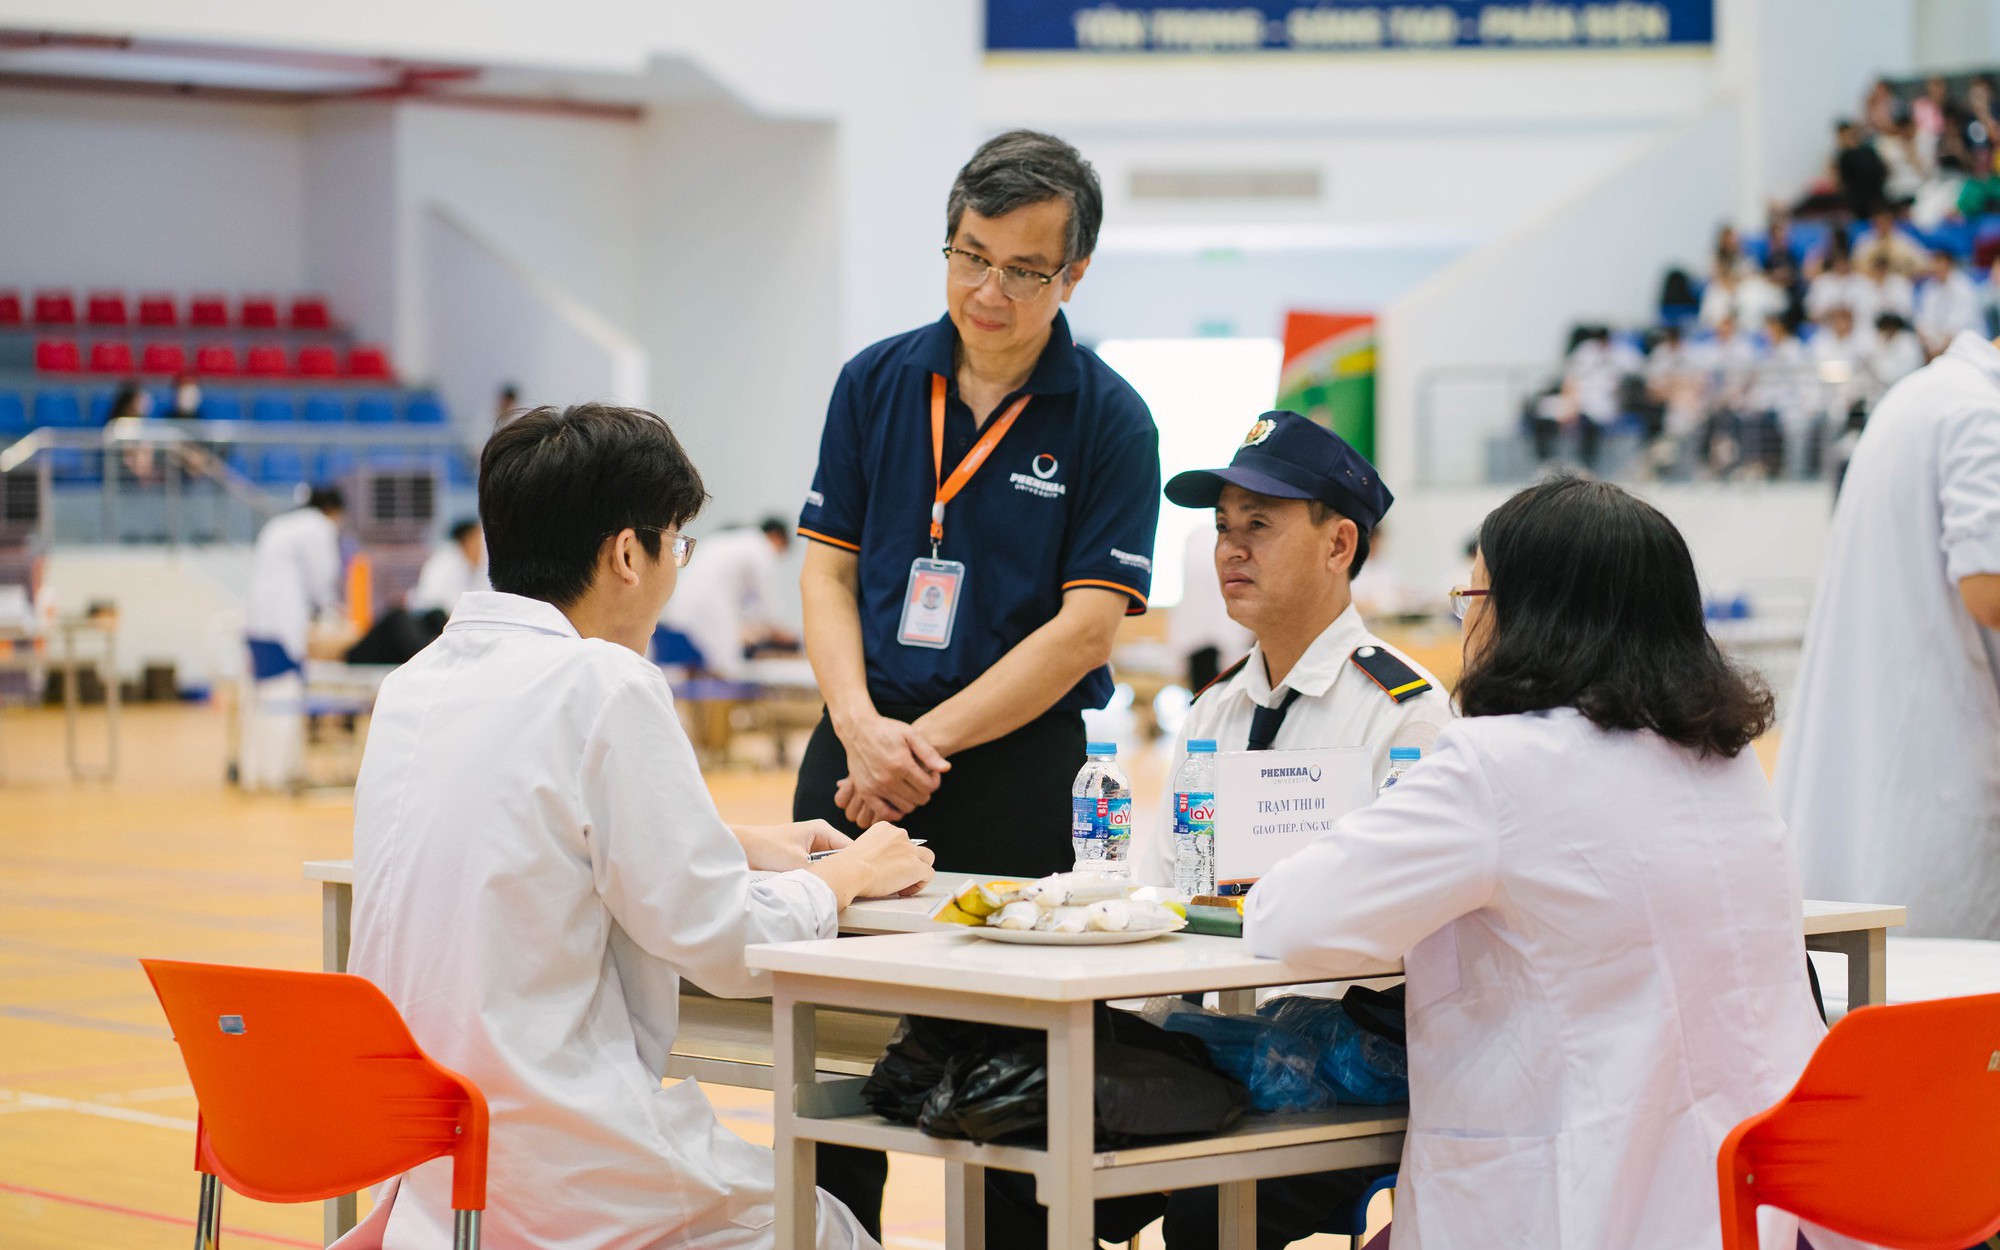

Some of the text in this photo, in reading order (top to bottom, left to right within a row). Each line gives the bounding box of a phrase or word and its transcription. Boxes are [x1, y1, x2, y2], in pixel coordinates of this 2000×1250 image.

[1010, 472, 1066, 495] PHENIKAA
[1261, 767, 1308, 778] PHENIKAA
[1257, 797, 1325, 815] TRẠM THI 01
[1252, 824, 1275, 835] GIAO
